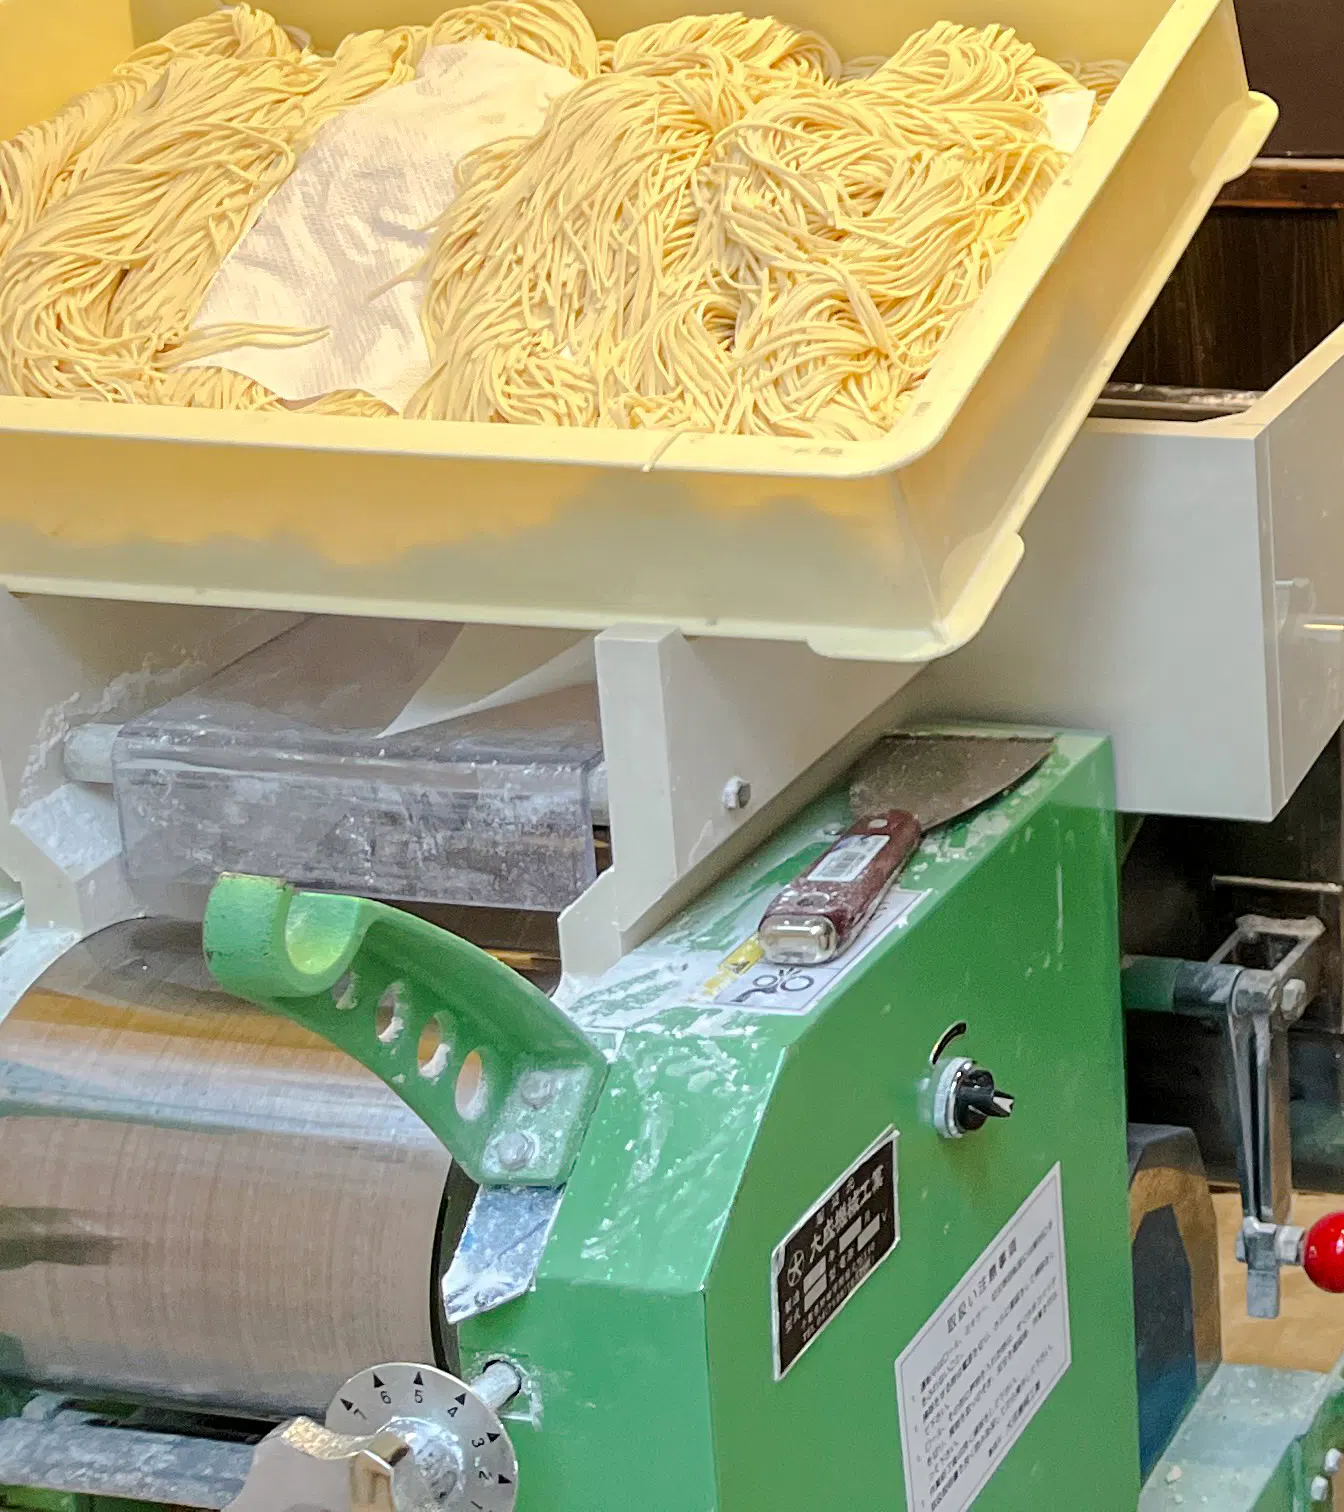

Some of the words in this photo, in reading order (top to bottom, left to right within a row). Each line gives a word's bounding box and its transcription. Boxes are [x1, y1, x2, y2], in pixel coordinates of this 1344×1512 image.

[380, 1390, 392, 1405] 6
[413, 1390, 423, 1404] 5
[447, 1406, 458, 1418] 4
[472, 1437, 485, 1448] 3
